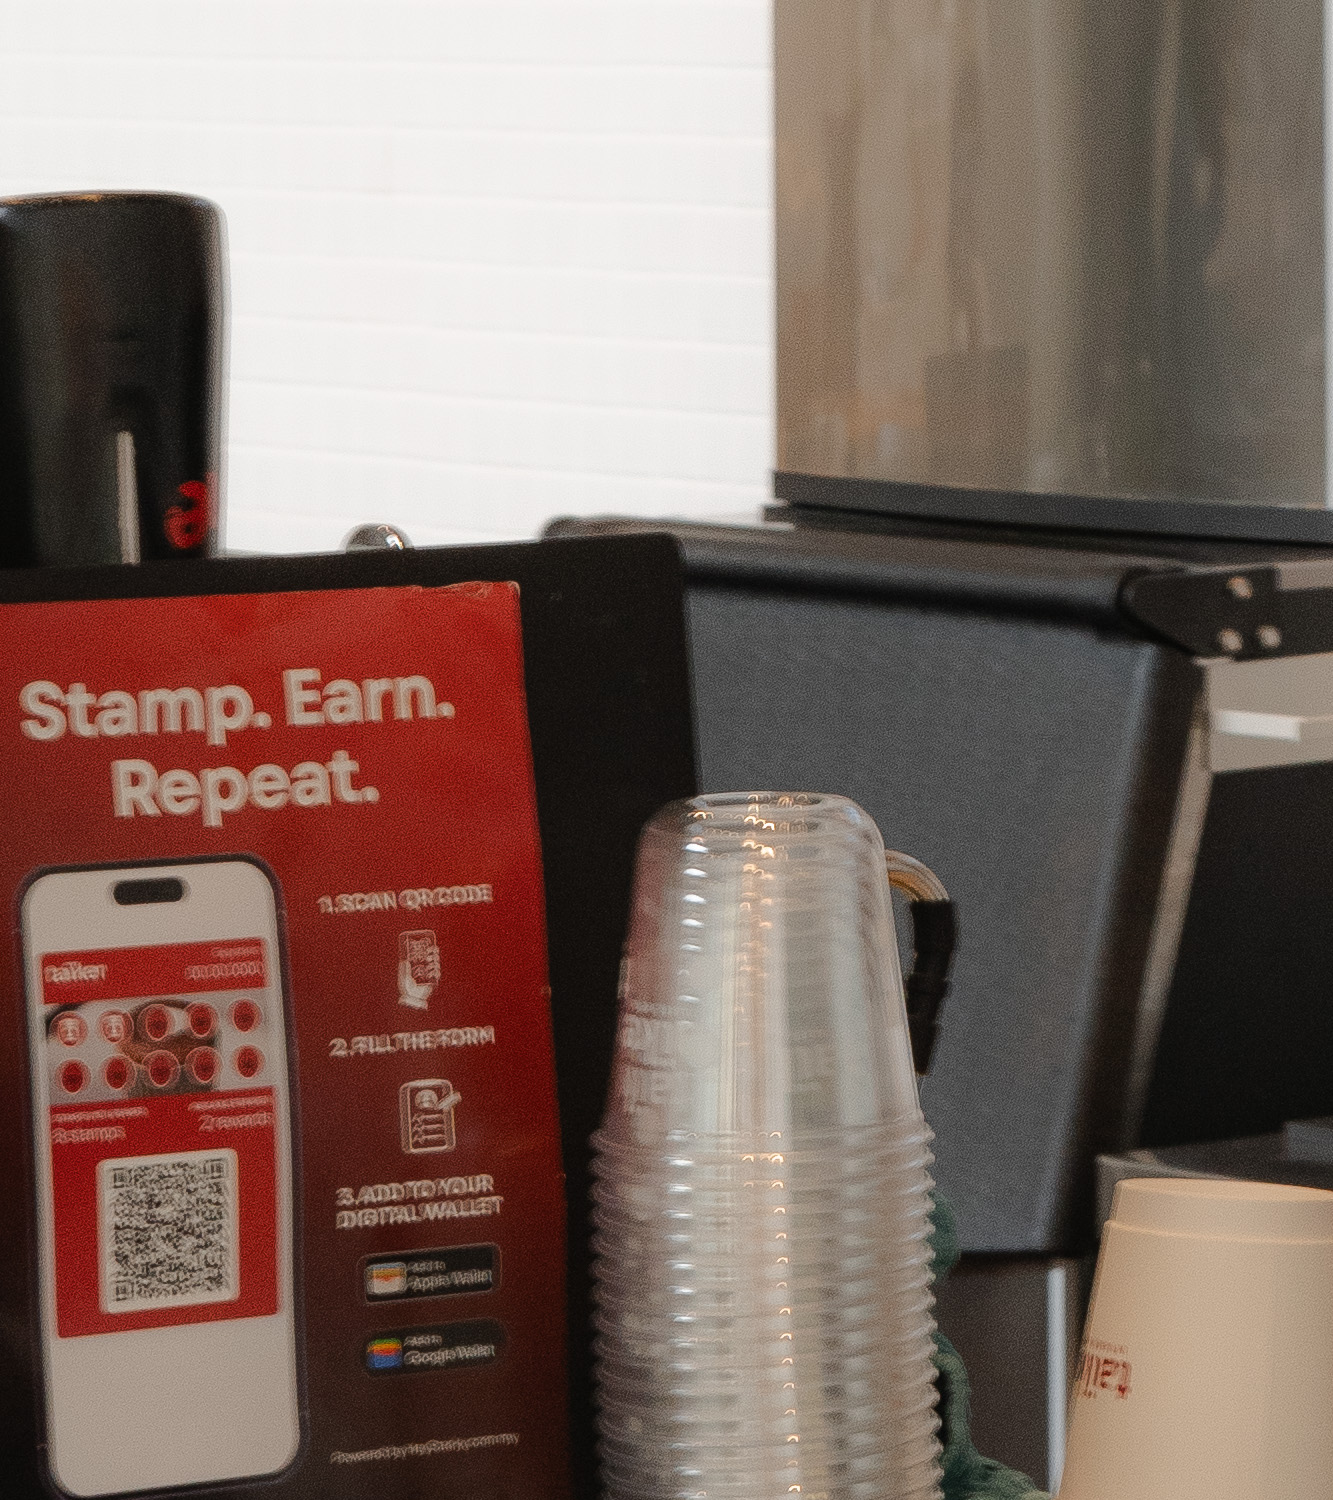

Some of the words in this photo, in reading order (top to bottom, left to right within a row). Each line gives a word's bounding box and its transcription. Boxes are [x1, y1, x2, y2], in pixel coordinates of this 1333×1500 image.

[20, 680, 272, 746] Stamp.
[283, 668, 456, 727] Earn.
[111, 750, 380, 828] Repeat.
